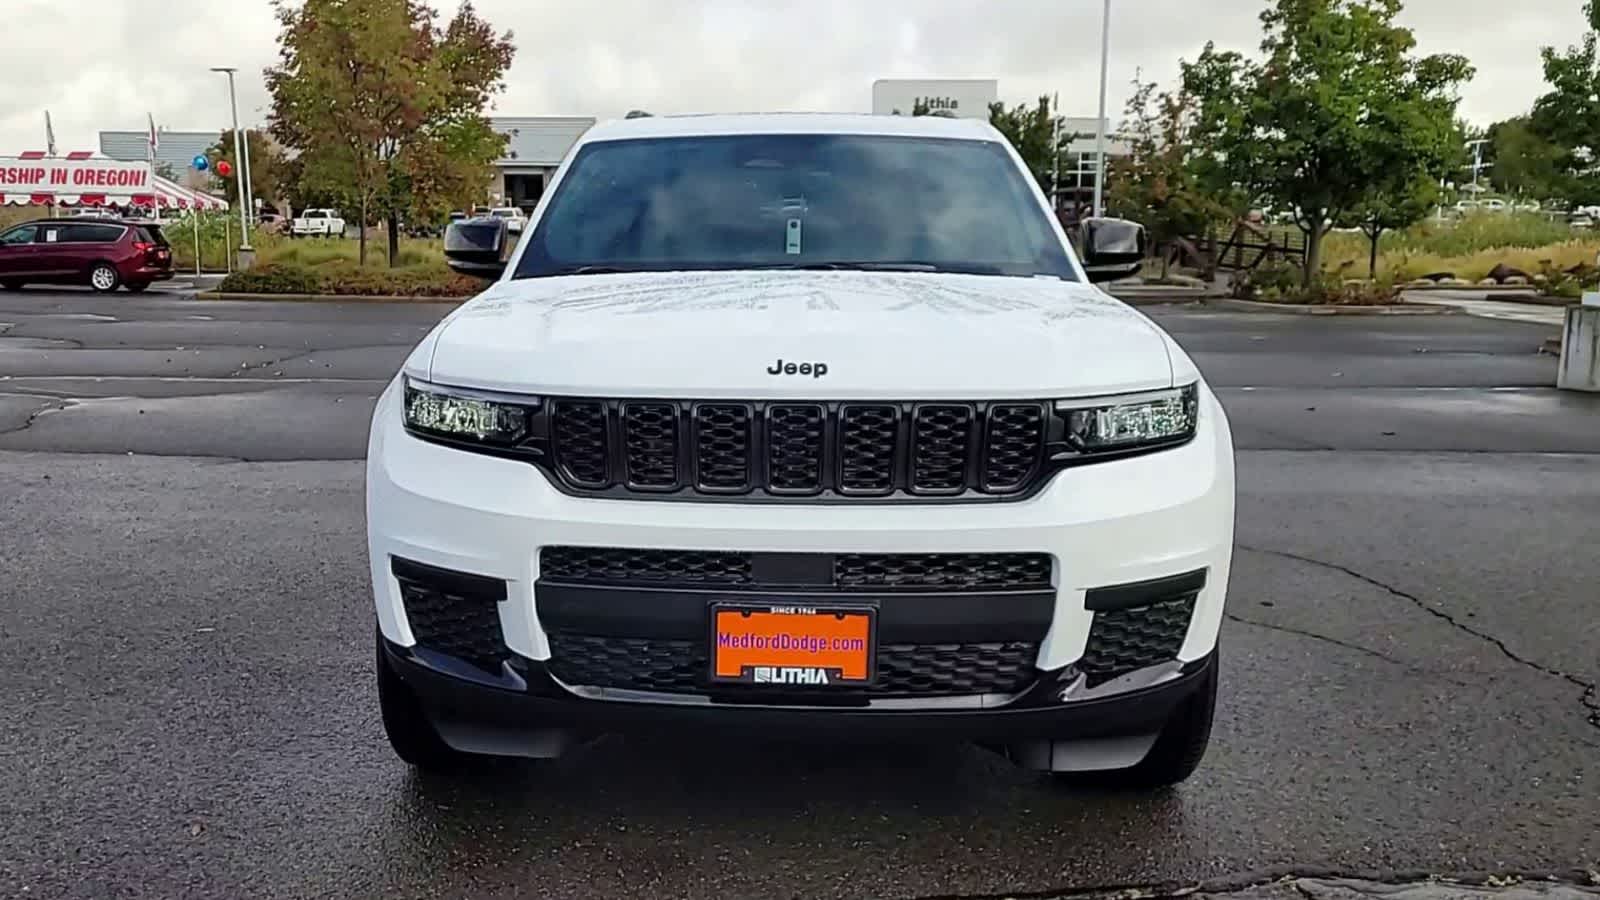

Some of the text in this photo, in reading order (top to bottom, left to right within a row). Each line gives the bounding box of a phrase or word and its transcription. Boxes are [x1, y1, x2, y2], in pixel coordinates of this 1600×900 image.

[914, 96, 959, 109] Lithia
[50, 168, 68, 185] IN
[73, 168, 147, 187] OREGON!
[767, 359, 828, 379] Jeep
[770, 606, 795, 615] SINCE
[718, 632, 864, 652] MedfordDodge.com
[771, 667, 829, 685] LITHIA
